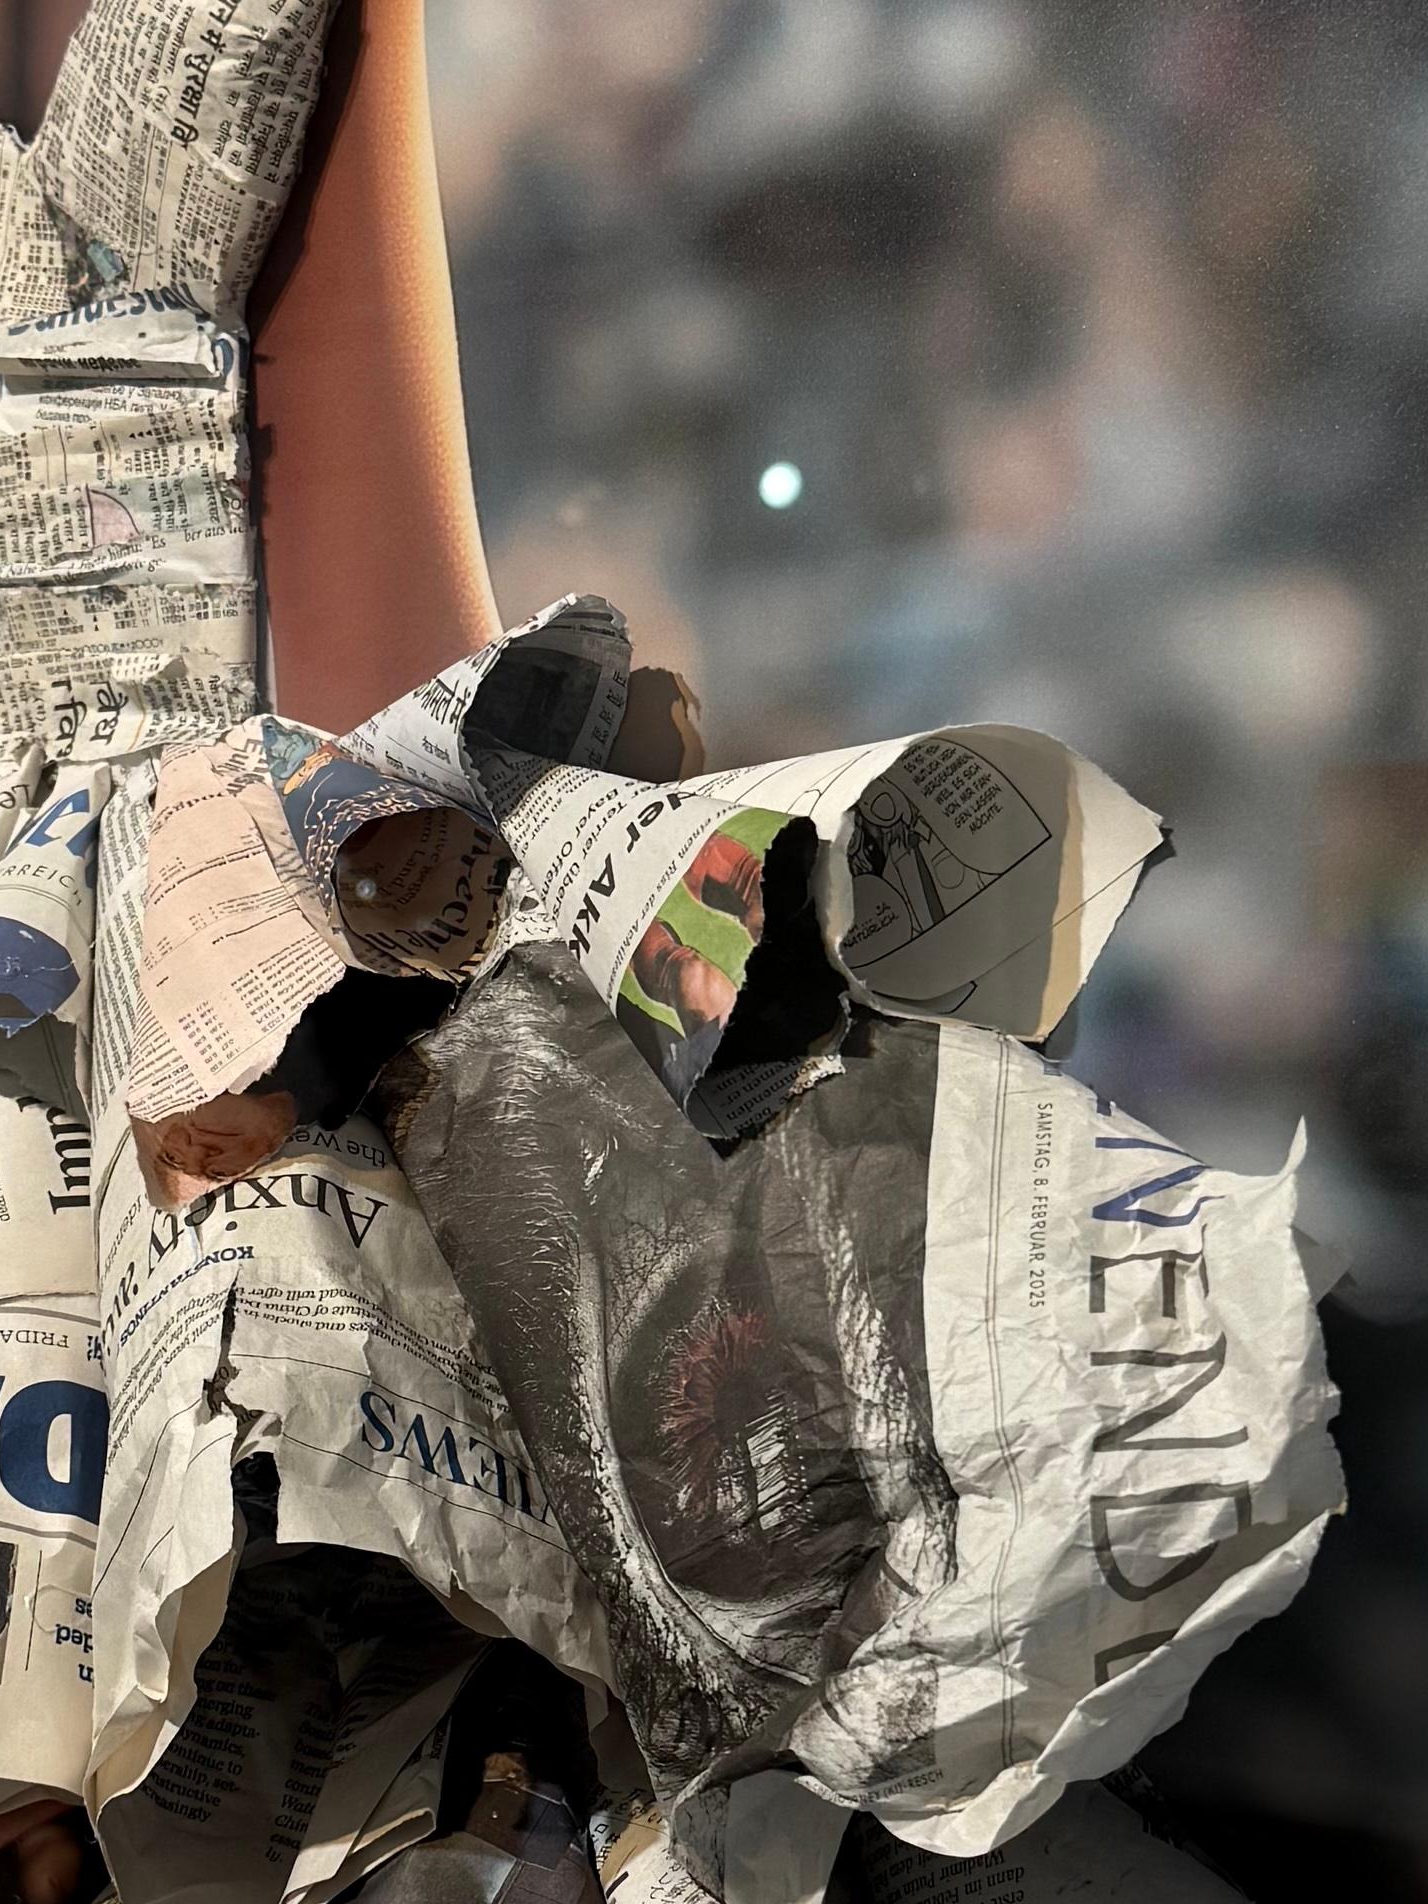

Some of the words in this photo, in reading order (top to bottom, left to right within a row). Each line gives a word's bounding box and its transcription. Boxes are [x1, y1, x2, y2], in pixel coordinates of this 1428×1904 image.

[1032, 1102, 1053, 1173] SAMSTAG,
[1028, 1195, 1048, 1262] FEBRUAR
[1028, 1268, 1045, 1307] 2025
